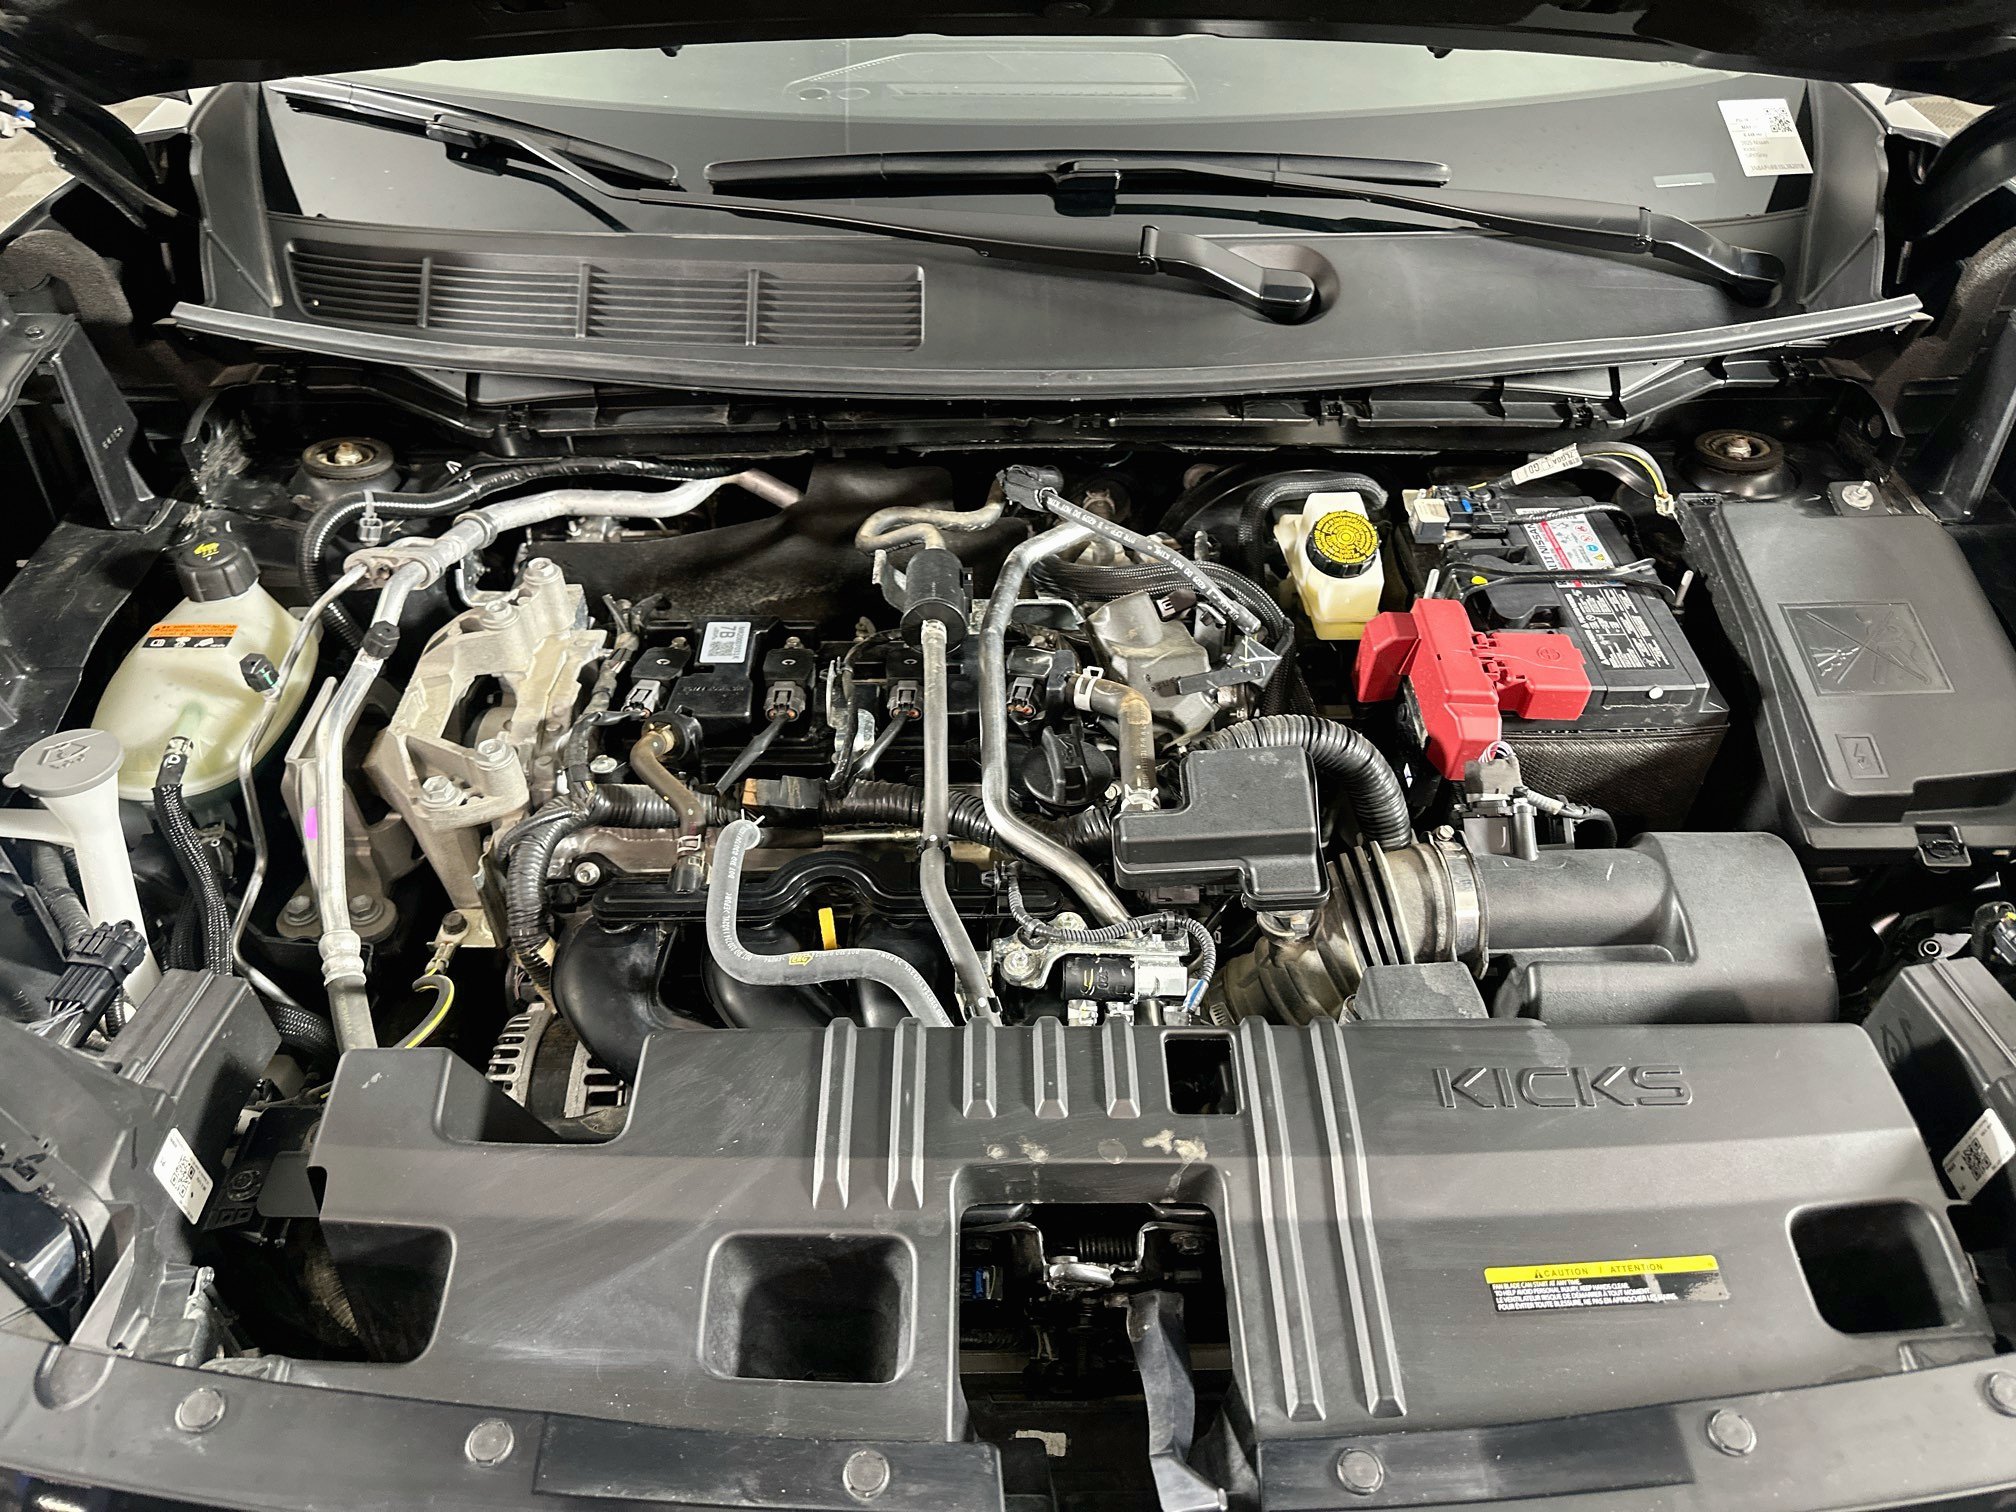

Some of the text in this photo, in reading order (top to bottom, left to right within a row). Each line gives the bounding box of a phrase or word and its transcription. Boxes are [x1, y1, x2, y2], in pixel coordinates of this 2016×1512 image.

[1527, 523, 1548, 554] NISSAN
[1170, 557, 1185, 570] NOT
[1183, 567, 1194, 578] DO
[720, 625, 737, 638] 7B
[1433, 1065, 1693, 1109] KICKS
[1544, 1267, 1589, 1278] CAUTION
[1610, 1263, 1663, 1274] ATTENTION
[1494, 1289, 1502, 1297] TO
[1502, 1289, 1516, 1297] HELP
[1533, 1286, 1560, 1295] PERSONAL
[1579, 1284, 1592, 1292] KEEP
[1593, 1283, 1611, 1291] HANDS
[1496, 1296, 1503, 1304] LE
[1503, 1294, 1540, 1303] VENTILATEUR
[1540, 1293, 1562, 1301] RISQUE
[1608, 1288, 1623, 1296] TOUT
[1498, 1303, 1515, 1311] POUR
[1535, 1300, 1553, 1308] TOUTE
[1592, 1297, 1604, 1305] PAS
[1612, 1295, 1647, 1304] APPROCHER
